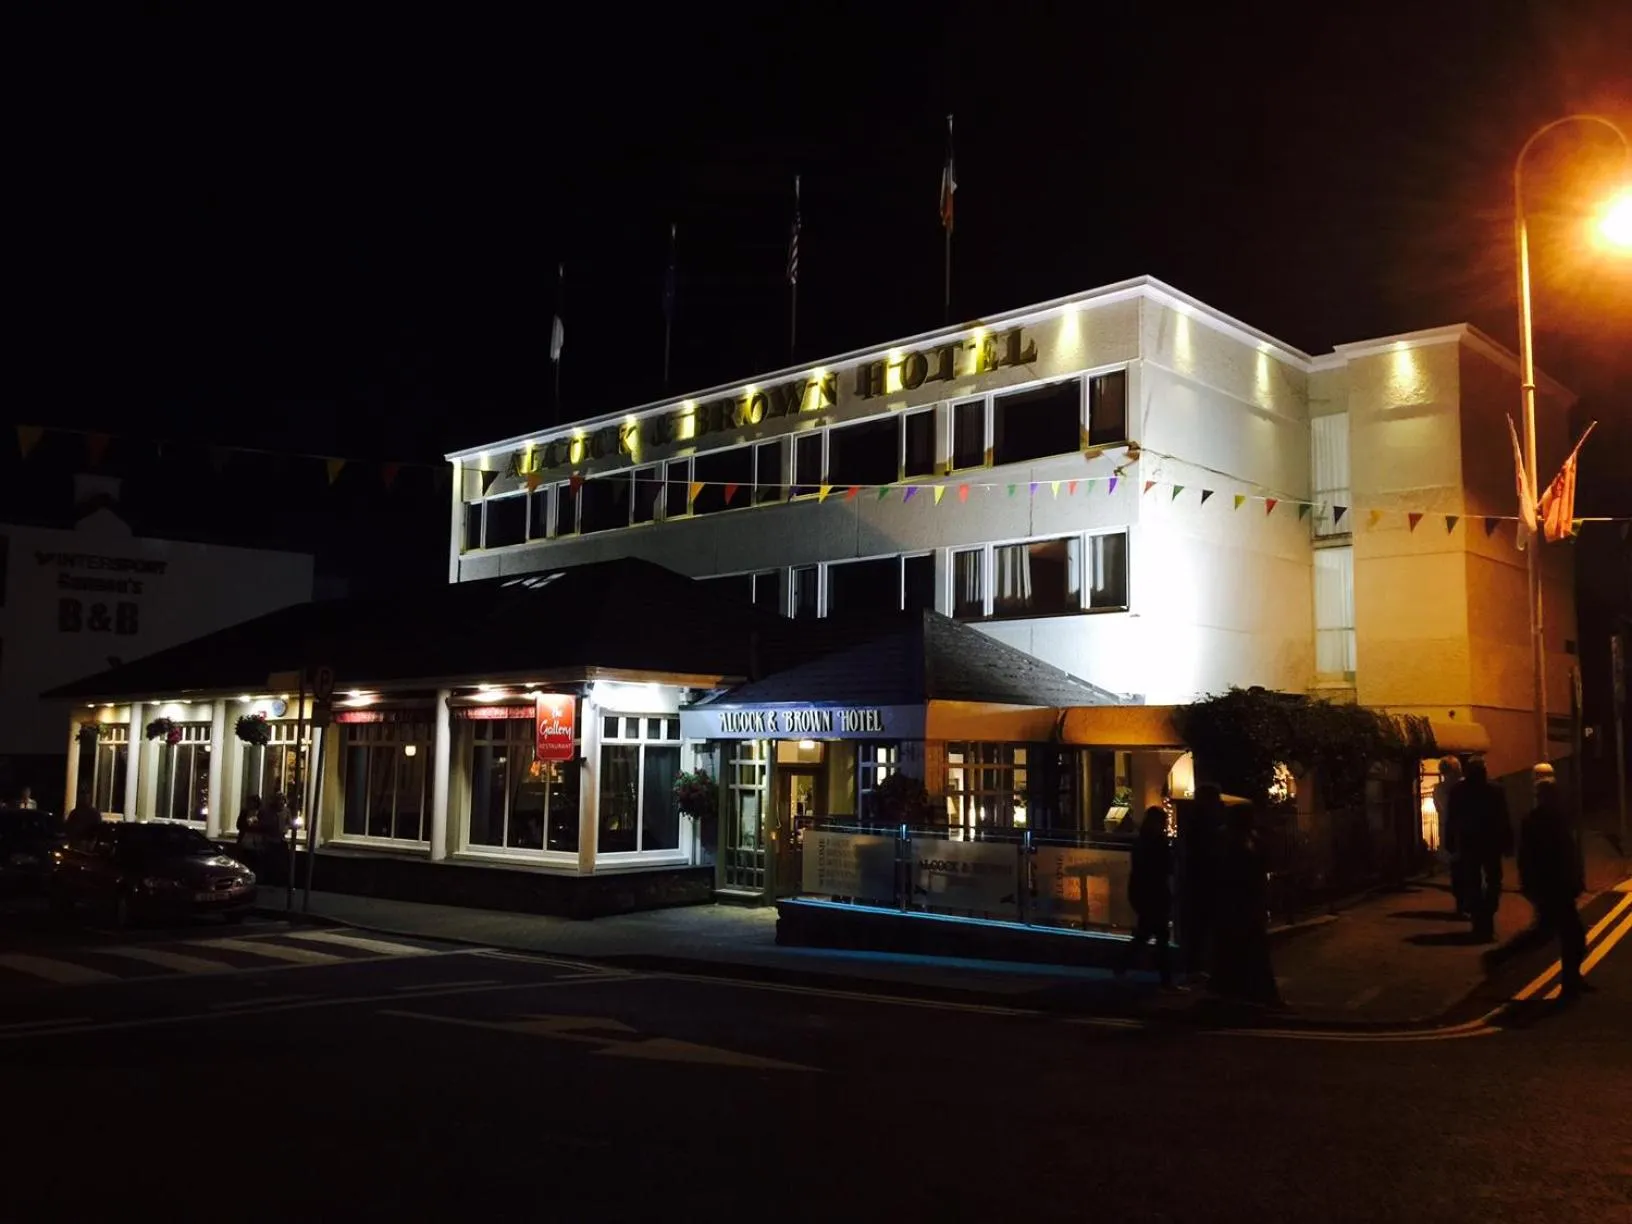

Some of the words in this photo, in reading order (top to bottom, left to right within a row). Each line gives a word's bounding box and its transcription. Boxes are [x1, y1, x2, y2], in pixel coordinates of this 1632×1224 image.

[691, 370, 838, 438] BROWN
[854, 328, 1038, 401] HOTEL
[58, 598, 139, 635] B&B
[540, 719, 571, 741] Gallery
[720, 710, 766, 733] ALCOCK
[767, 710, 779, 733] &
[782, 710, 833, 733] BROWN
[837, 709, 884, 733] HOTEL
